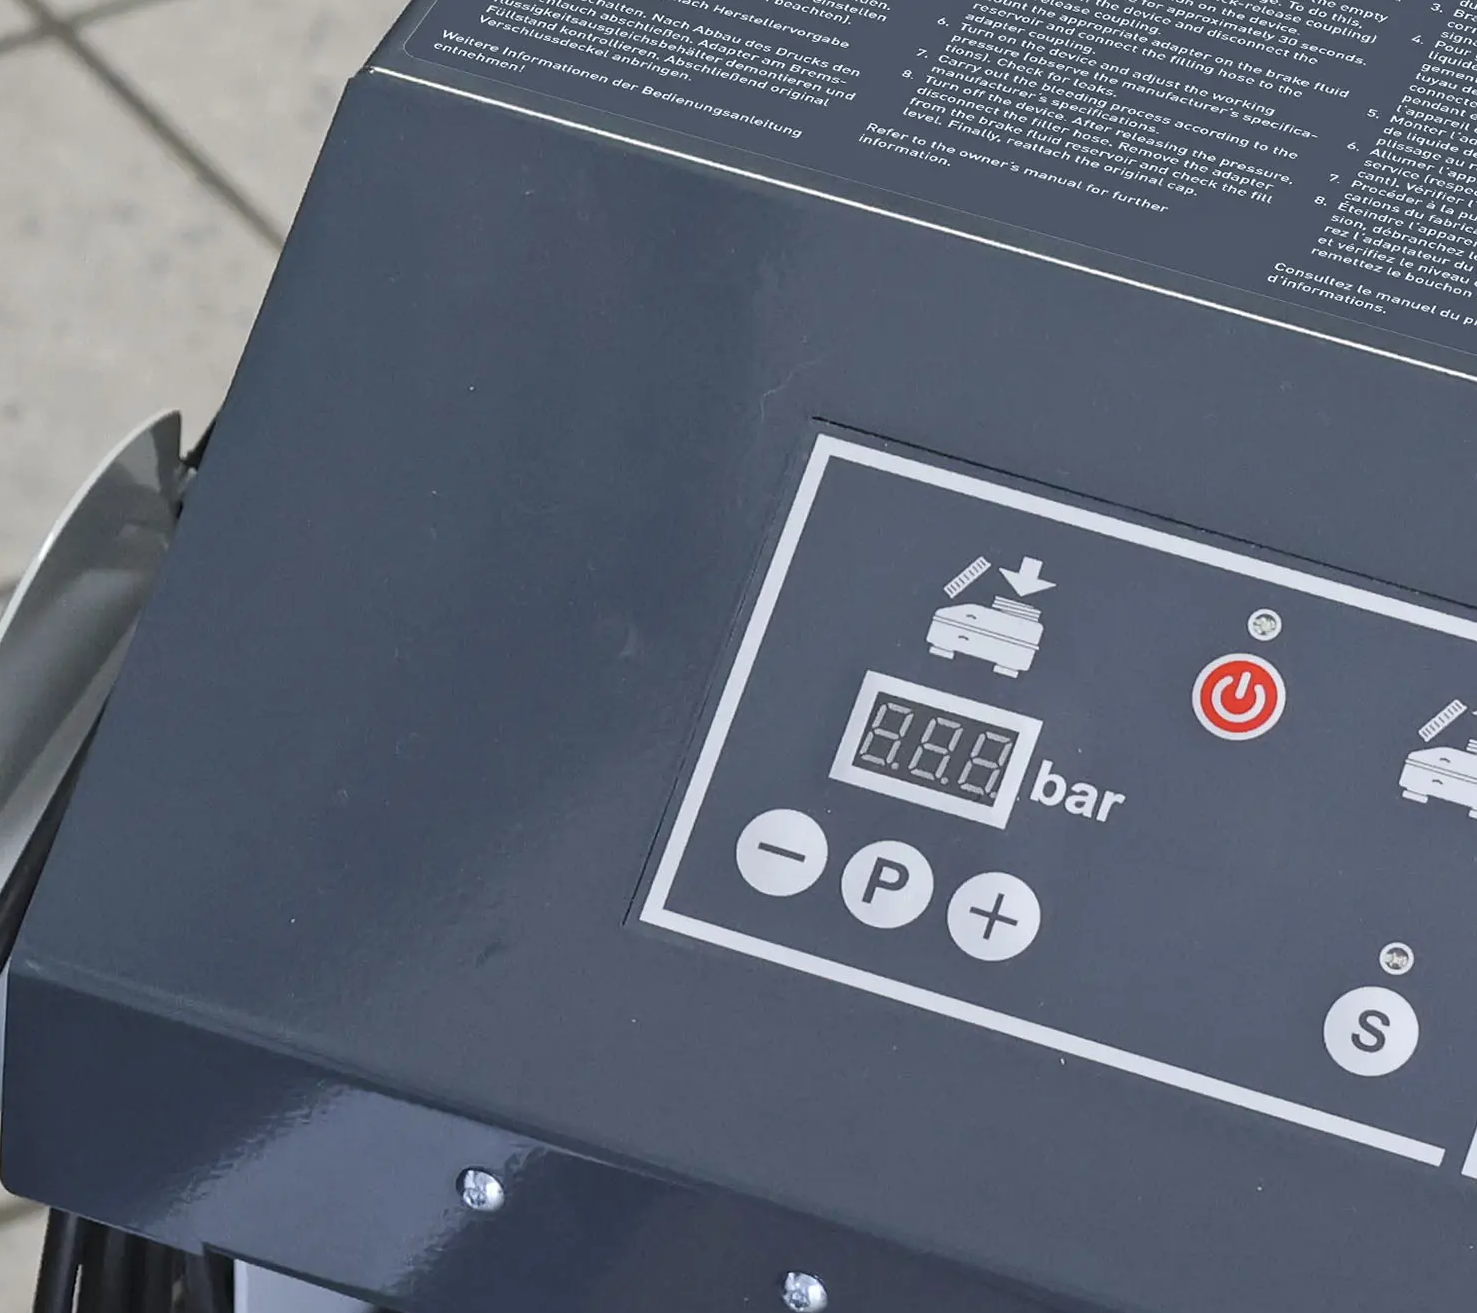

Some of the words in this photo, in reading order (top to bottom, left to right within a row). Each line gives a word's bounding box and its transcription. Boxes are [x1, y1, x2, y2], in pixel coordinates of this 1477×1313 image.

[433, 42, 526, 73] entnehmen!
[964, 13, 1026, 34] adapter
[1028, 30, 1096, 55] coupling.
[1166, 6, 1276, 42] approximately
[1277, 35, 1299, 47] 30
[1299, 42, 1367, 66] seconds.
[442, 29, 500, 53] Weitere
[501, 46, 609, 84] Informationen
[611, 78, 639, 91] der
[858, 133, 951, 167] information.
[865, 122, 910, 141] Refer
[911, 135, 927, 146] to
[930, 140, 956, 154] the
[1023, 167, 1083, 190] manual
[1085, 183, 1110, 196] for
[1111, 190, 1169, 213] further
[1344, 192, 1400, 213] cations
[1403, 208, 1425, 220] du
[1274, 262, 1354, 292] Consultez
[1356, 284, 1372, 296] le
[1375, 291, 1437, 315] manuel
[1439, 308, 1461, 321] du
[1030, 759, 1126, 822] bar
[864, 857, 909, 904] P
[1351, 1009, 1390, 1054] S
